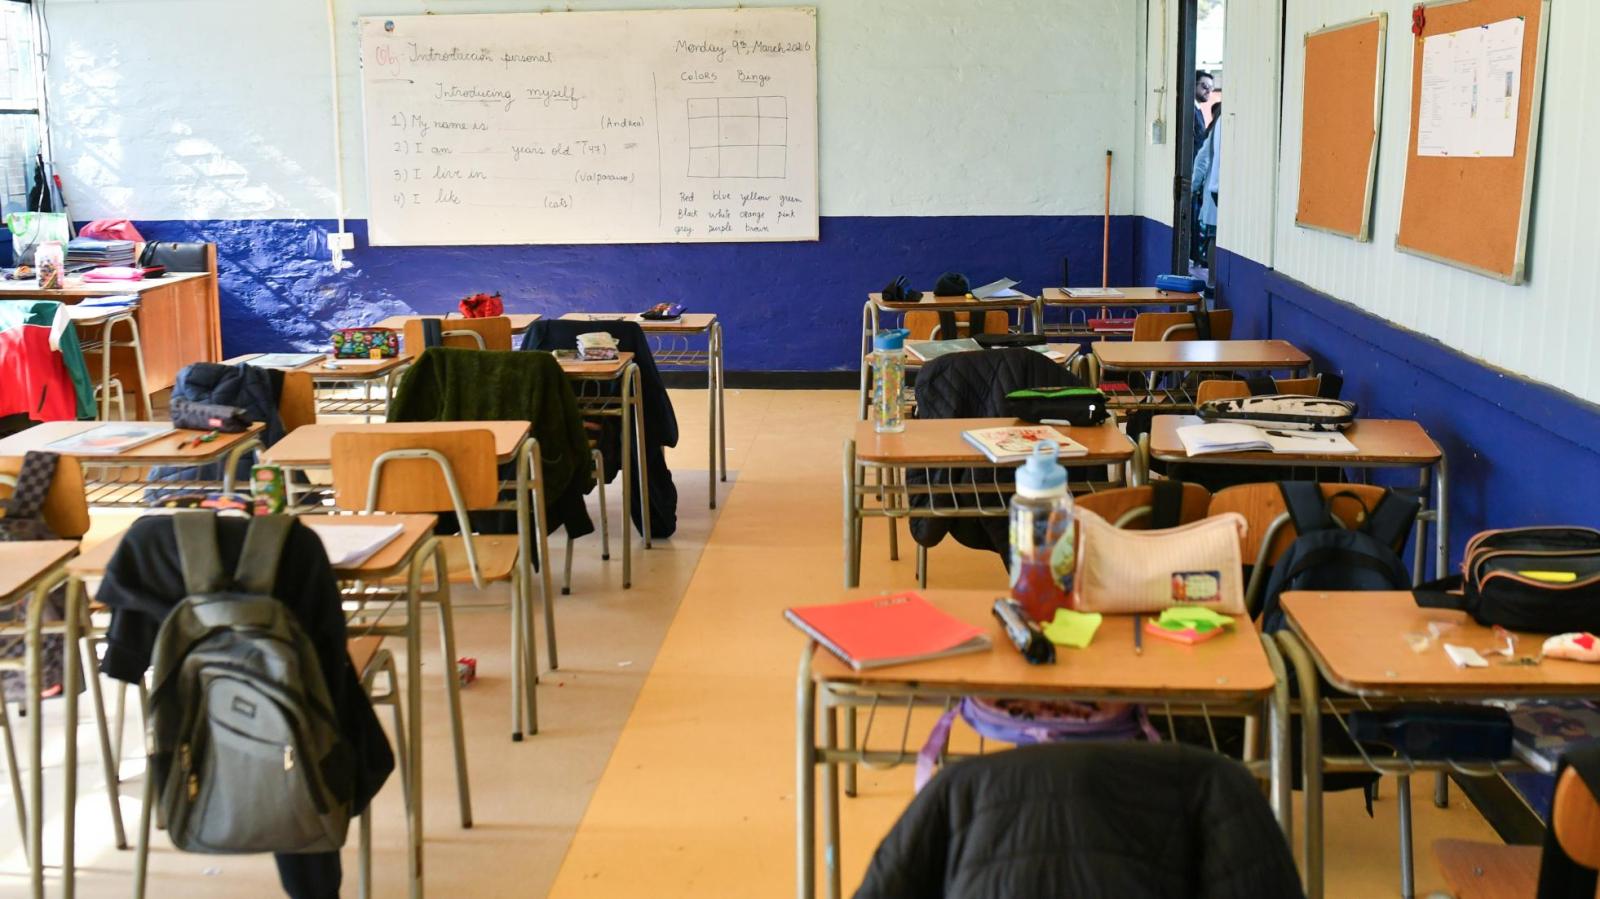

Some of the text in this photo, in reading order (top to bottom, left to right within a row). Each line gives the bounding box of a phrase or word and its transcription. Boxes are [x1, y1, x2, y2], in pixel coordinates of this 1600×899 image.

[501, 51, 552, 70] personal
[675, 39, 727, 63] Monday
[752, 40, 786, 54] March
[435, 82, 582, 112] Introducing myself
[391, 112, 407, 129] 1)
[411, 114, 429, 137] My
[433, 121, 468, 131] name
[471, 119, 489, 131] is
[393, 140, 409, 154] 2)
[415, 142, 423, 154] I
[431, 145, 453, 154] am
[512, 144, 544, 161] years
[551, 142, 573, 156] old
[393, 168, 409, 182] 3)
[413, 168, 422, 181] I
[433, 165, 463, 180] live
[468, 168, 487, 180] in
[393, 189, 573, 209] 4) I like (cats)
[712, 190, 731, 201] blue
[741, 192, 771, 206] yellow
[779, 194, 803, 207] green
[708, 207, 731, 219] white
[777, 210, 796, 224] pink
[745, 223, 770, 233] brown
